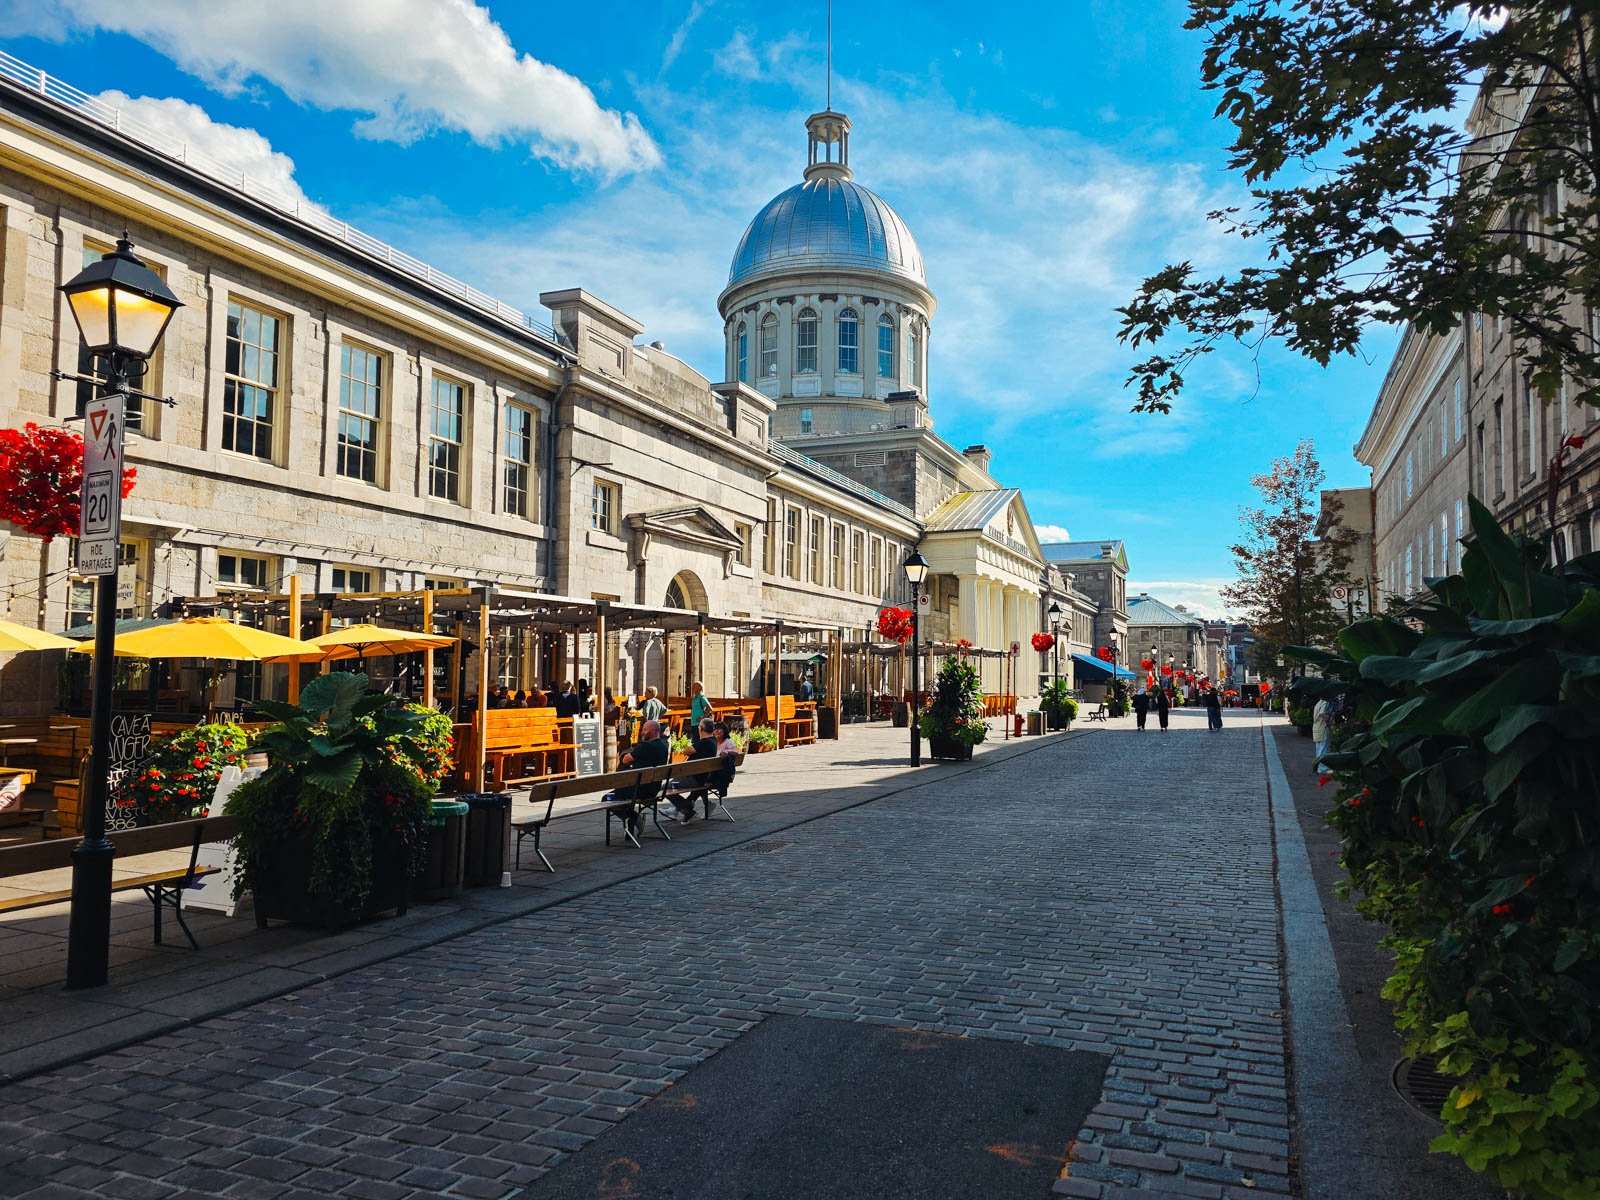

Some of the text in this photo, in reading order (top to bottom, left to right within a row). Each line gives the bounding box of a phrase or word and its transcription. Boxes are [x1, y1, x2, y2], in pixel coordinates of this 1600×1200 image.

[89, 479, 109, 488] MAXIMUM
[88, 493, 108, 523] 20
[81, 556, 112, 571] PARTAGÉE
